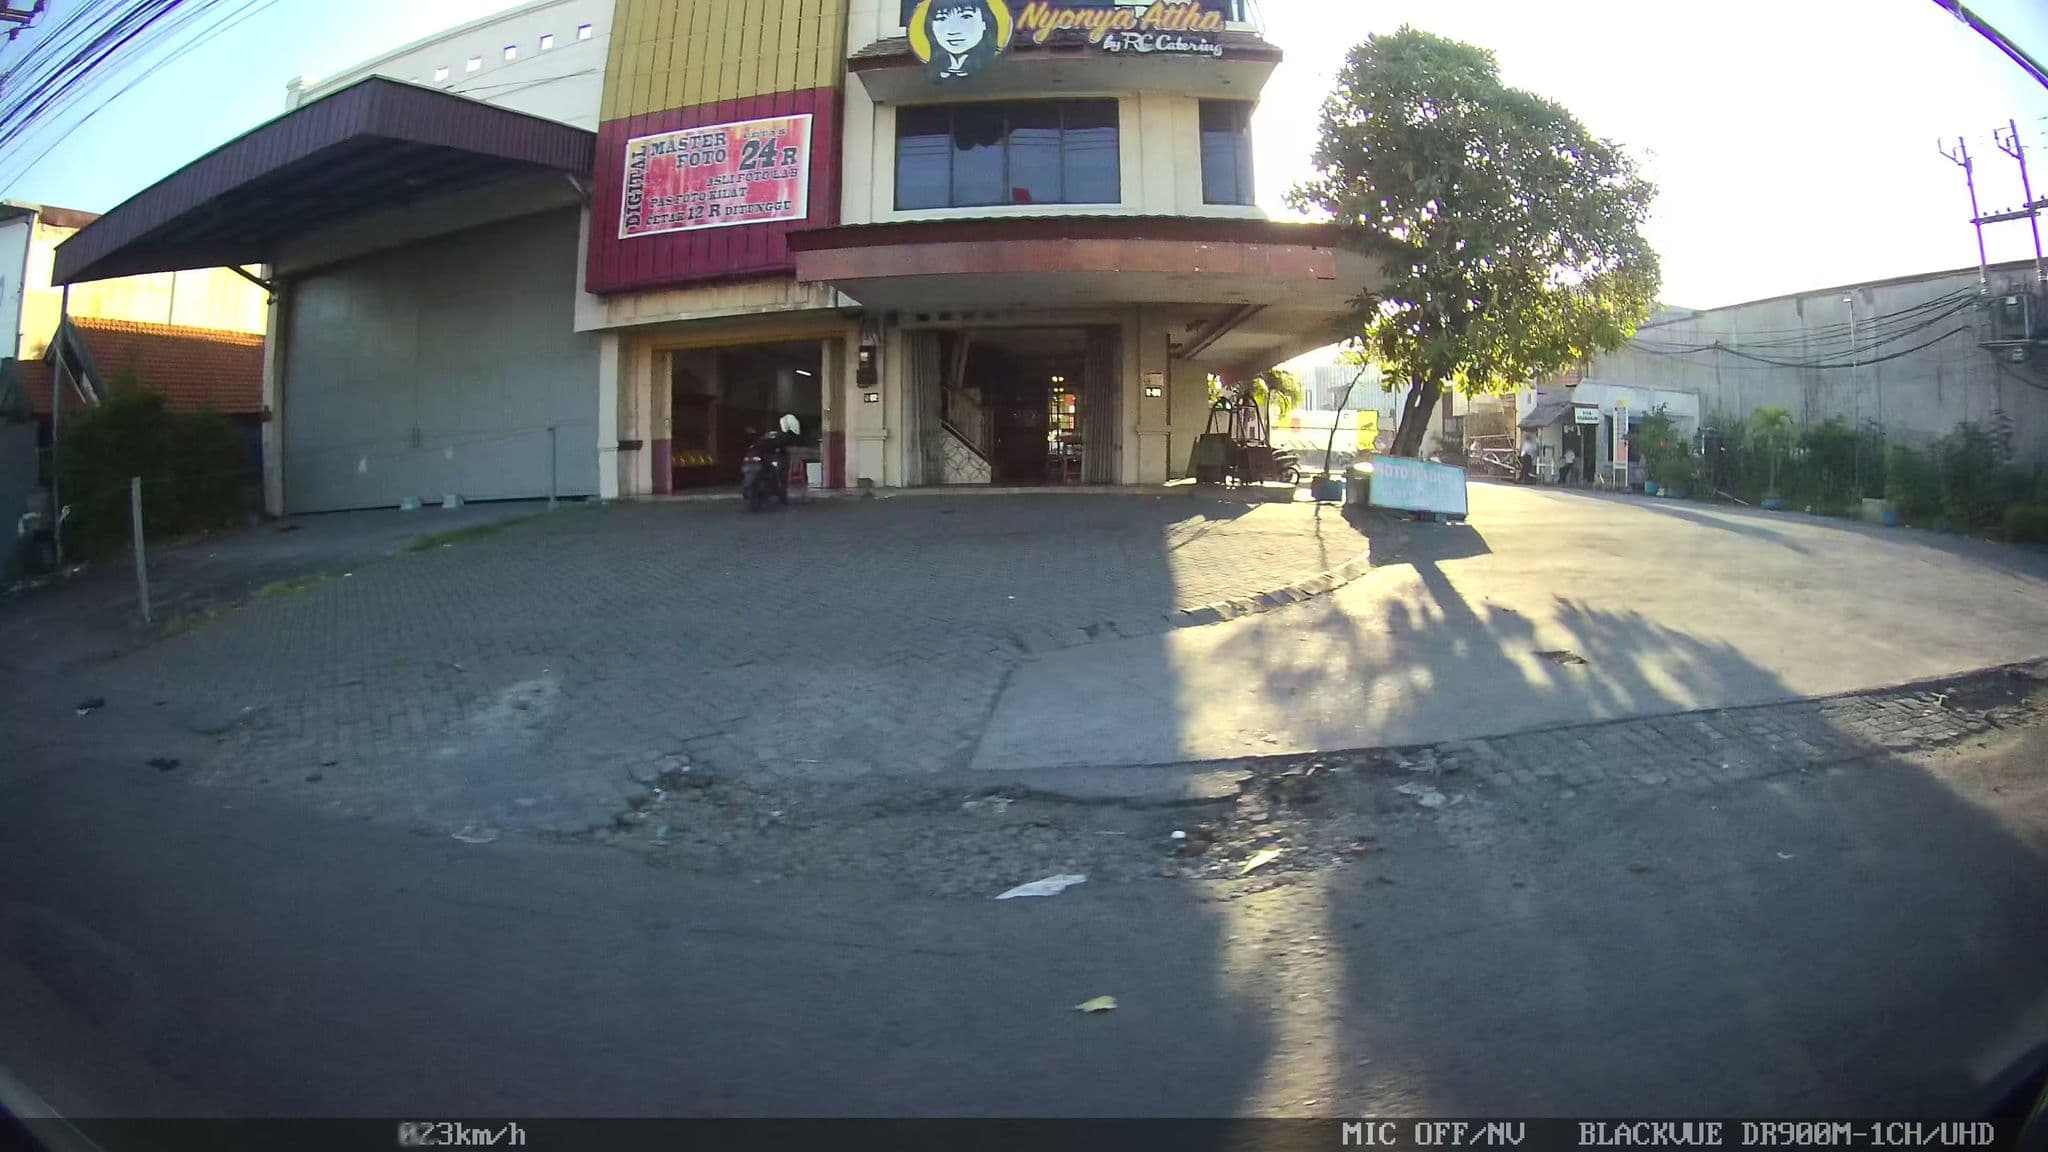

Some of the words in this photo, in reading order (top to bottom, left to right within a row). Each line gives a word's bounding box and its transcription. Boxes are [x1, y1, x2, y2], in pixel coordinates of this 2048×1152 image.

[1016, 1, 1136, 44] Nyonya
[1103, 34, 1120, 52] by
[1155, 34, 1223, 57] Catering
[651, 132, 726, 156] MASTER
[739, 138, 778, 171] 24
[781, 147, 798, 166] R
[677, 149, 726, 168] FOTO
[626, 145, 647, 227] DIGITAL
[736, 171, 770, 182] FOTO
[688, 205, 704, 219] 12
[709, 204, 721, 217] R
